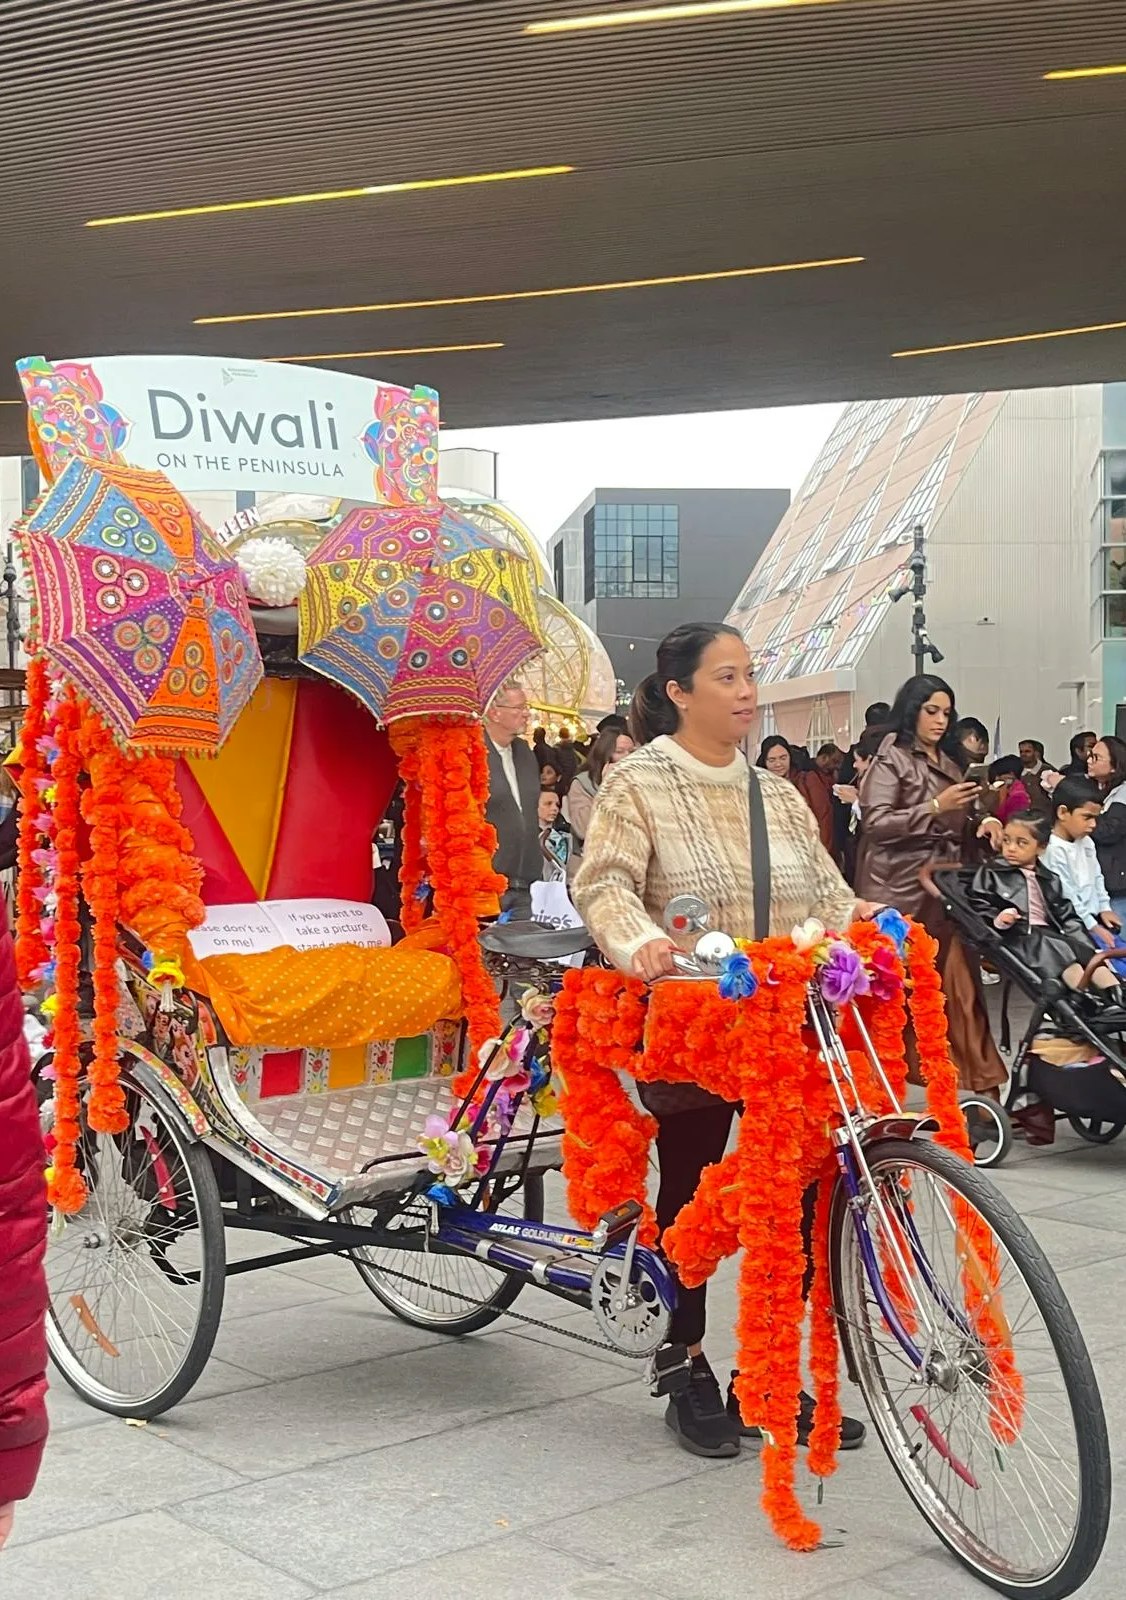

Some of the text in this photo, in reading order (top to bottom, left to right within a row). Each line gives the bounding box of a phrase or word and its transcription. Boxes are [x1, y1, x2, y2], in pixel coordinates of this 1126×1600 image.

[148, 389, 339, 450] Diwali
[157, 452, 344, 477] ON THE PENINSULA
[217, 506, 261, 544] TEEN
[288, 908, 363, 922] If you want to
[223, 924, 255, 933] don't
[256, 925, 271, 934] sit
[295, 923, 373, 935] take a picture,
[213, 938, 255, 948] on me!
[489, 1223, 521, 1236] ATLAS
